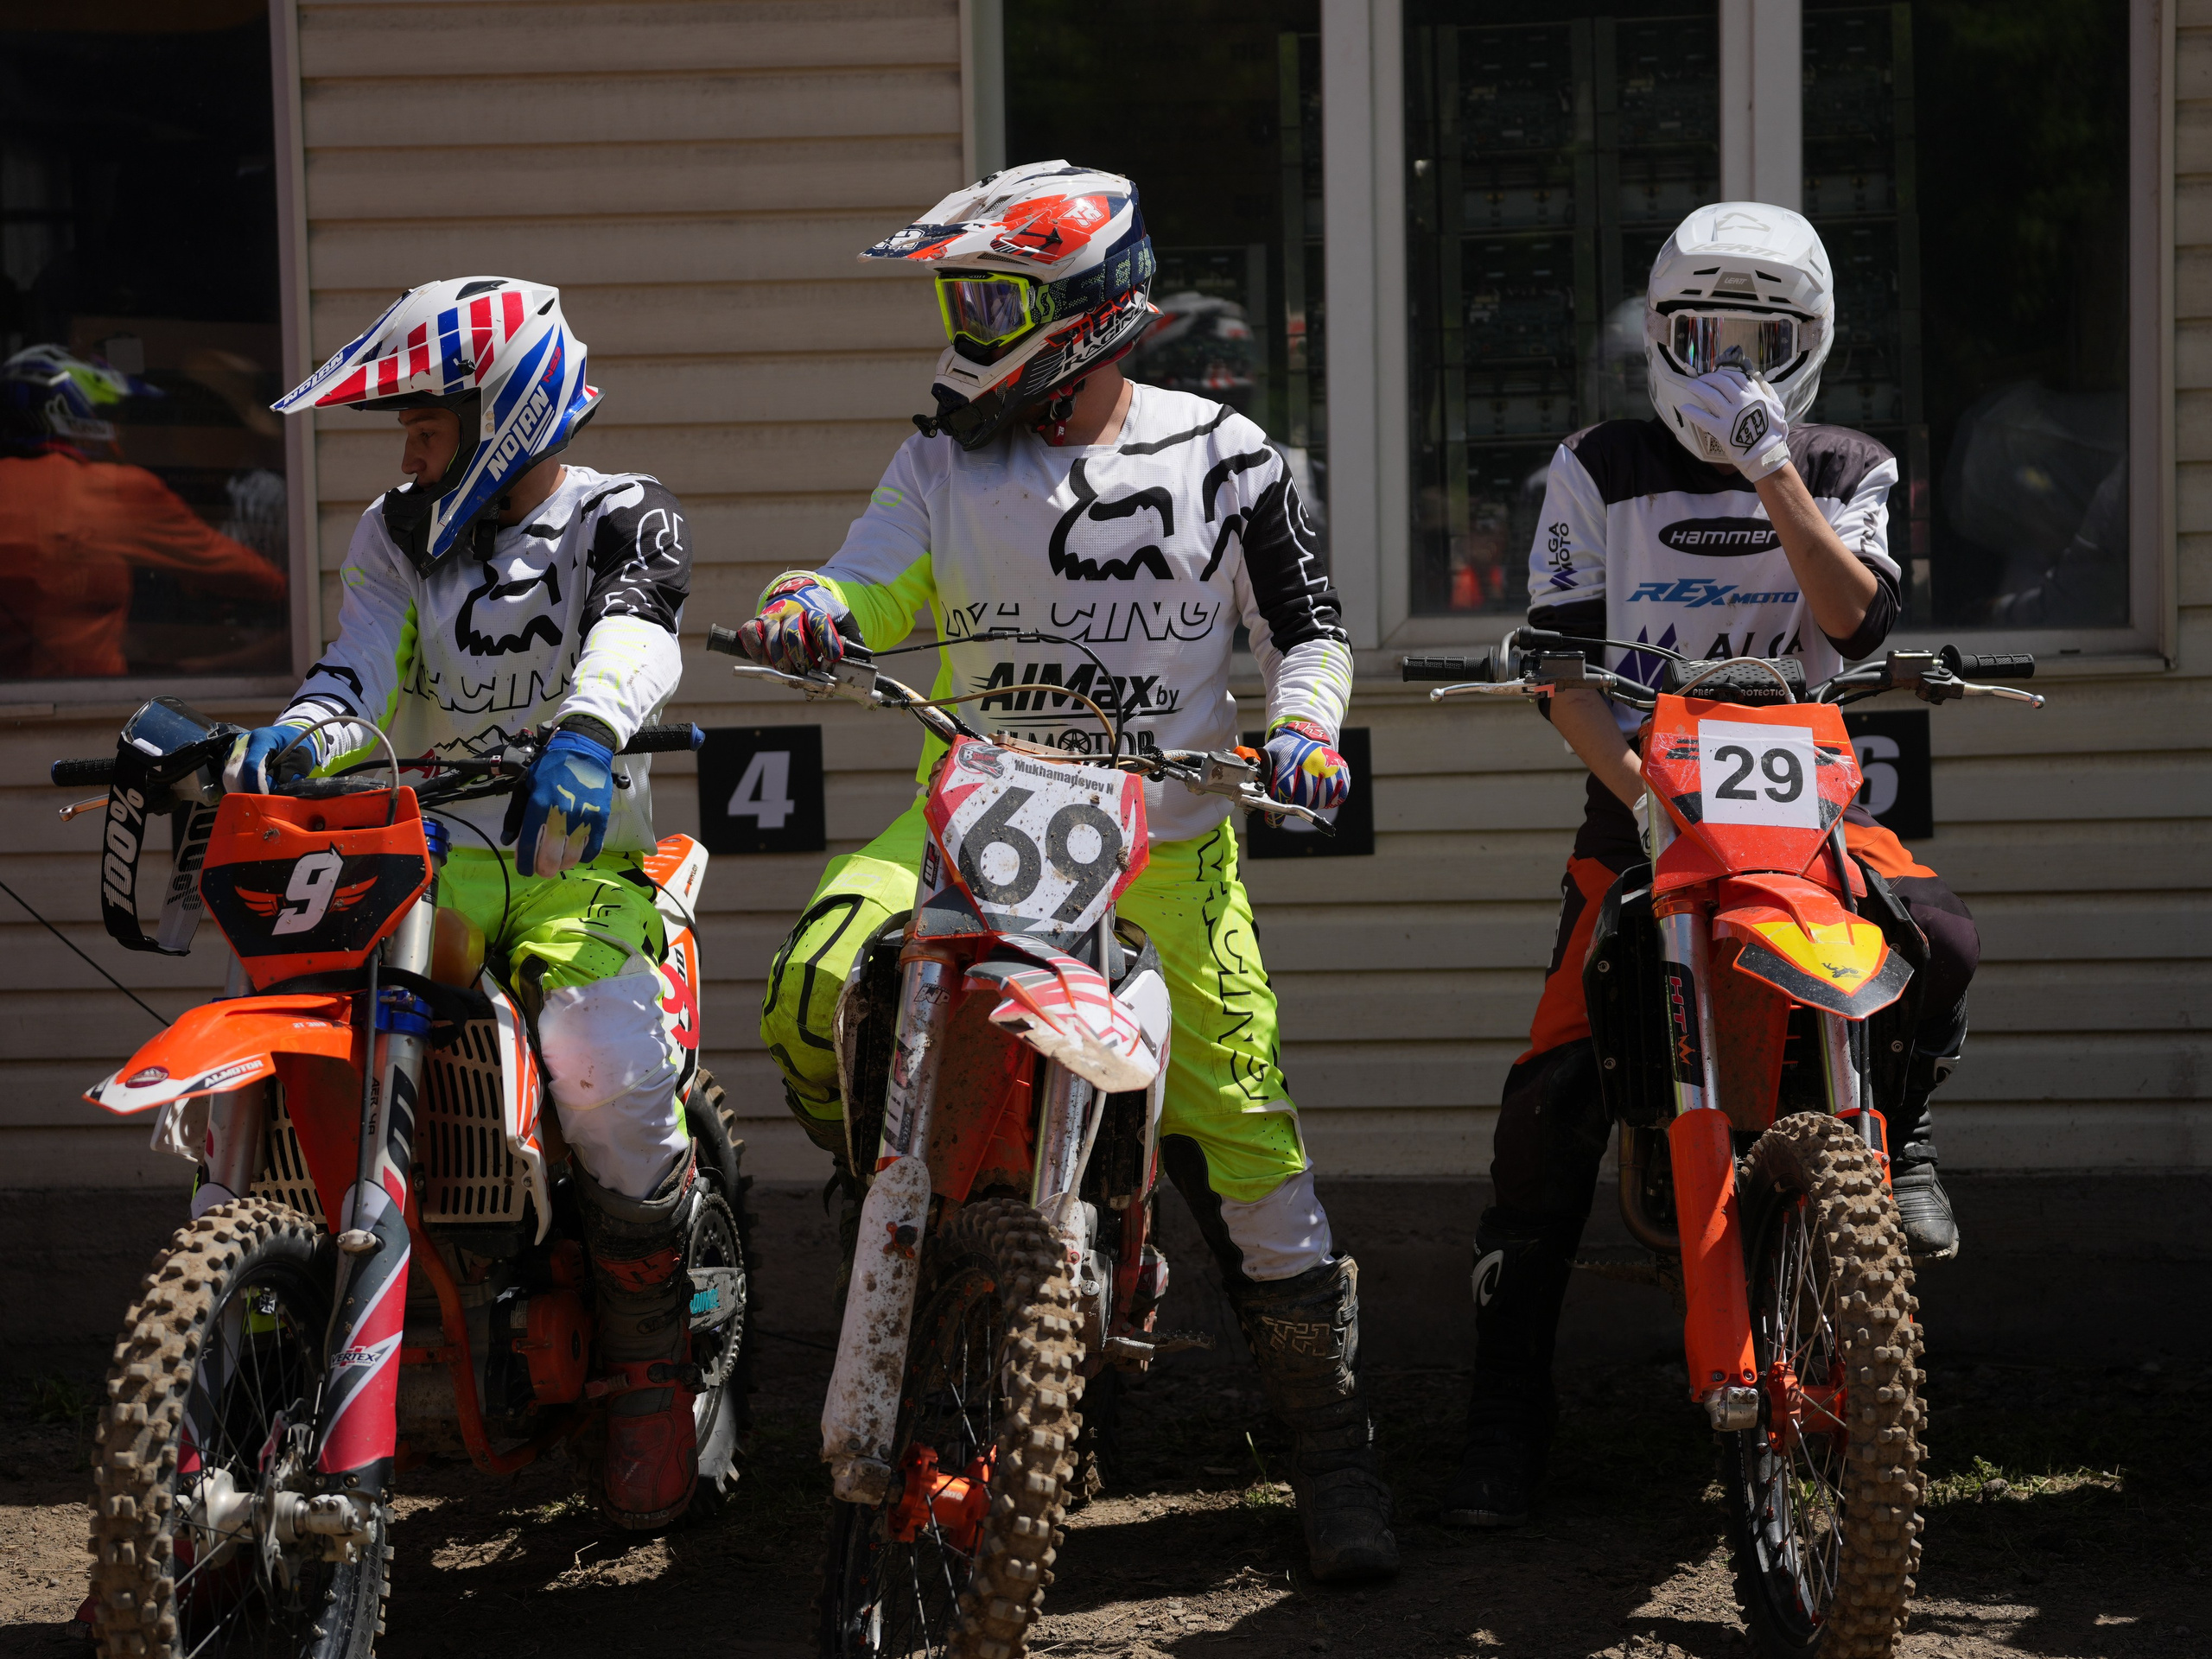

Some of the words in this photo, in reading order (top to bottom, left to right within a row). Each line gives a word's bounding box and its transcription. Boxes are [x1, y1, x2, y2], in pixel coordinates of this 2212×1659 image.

[1724, 276, 1747, 286] LEATT
[283, 351, 344, 405] NOLAN
[486, 385, 553, 482] NOLAN
[1625, 578, 1739, 608] REX
[1729, 591, 1800, 604] MOTO
[1156, 685, 1179, 710] by
[727, 751, 795, 830] 4
[1713, 745, 1804, 804] 29
[1852, 734, 1901, 817] 6
[103, 785, 145, 916] 100%
[957, 785, 1123, 925] 69
[271, 842, 345, 937] 9
[332, 1353, 376, 1363] VERTEX
